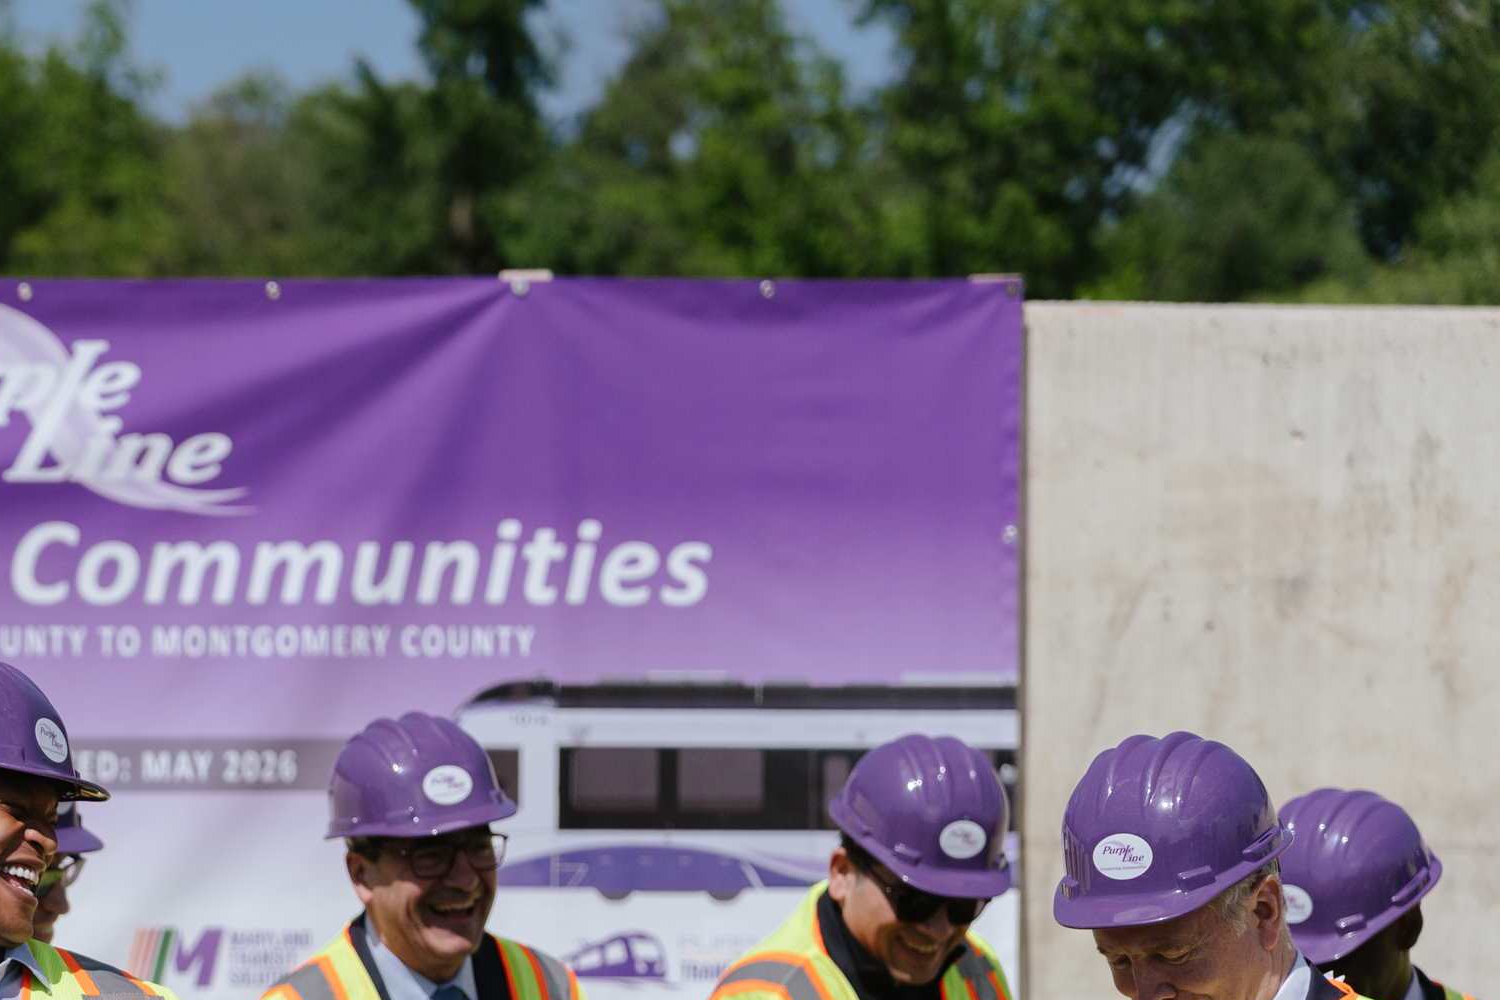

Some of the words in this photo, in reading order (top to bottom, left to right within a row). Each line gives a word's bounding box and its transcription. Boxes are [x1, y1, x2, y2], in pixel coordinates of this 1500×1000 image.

[1, 414, 233, 484] Line
[9, 518, 714, 607] Communities
[96, 624, 142, 658] TO
[151, 624, 391, 659] MONTGOMERY
[399, 624, 536, 659] COUNTY
[40, 726, 57, 740] Purple
[141, 749, 214, 783] MAY
[222, 749, 298, 784] 2026
[1102, 844, 1134, 856] Purple
[1122, 853, 1145, 863] Line
